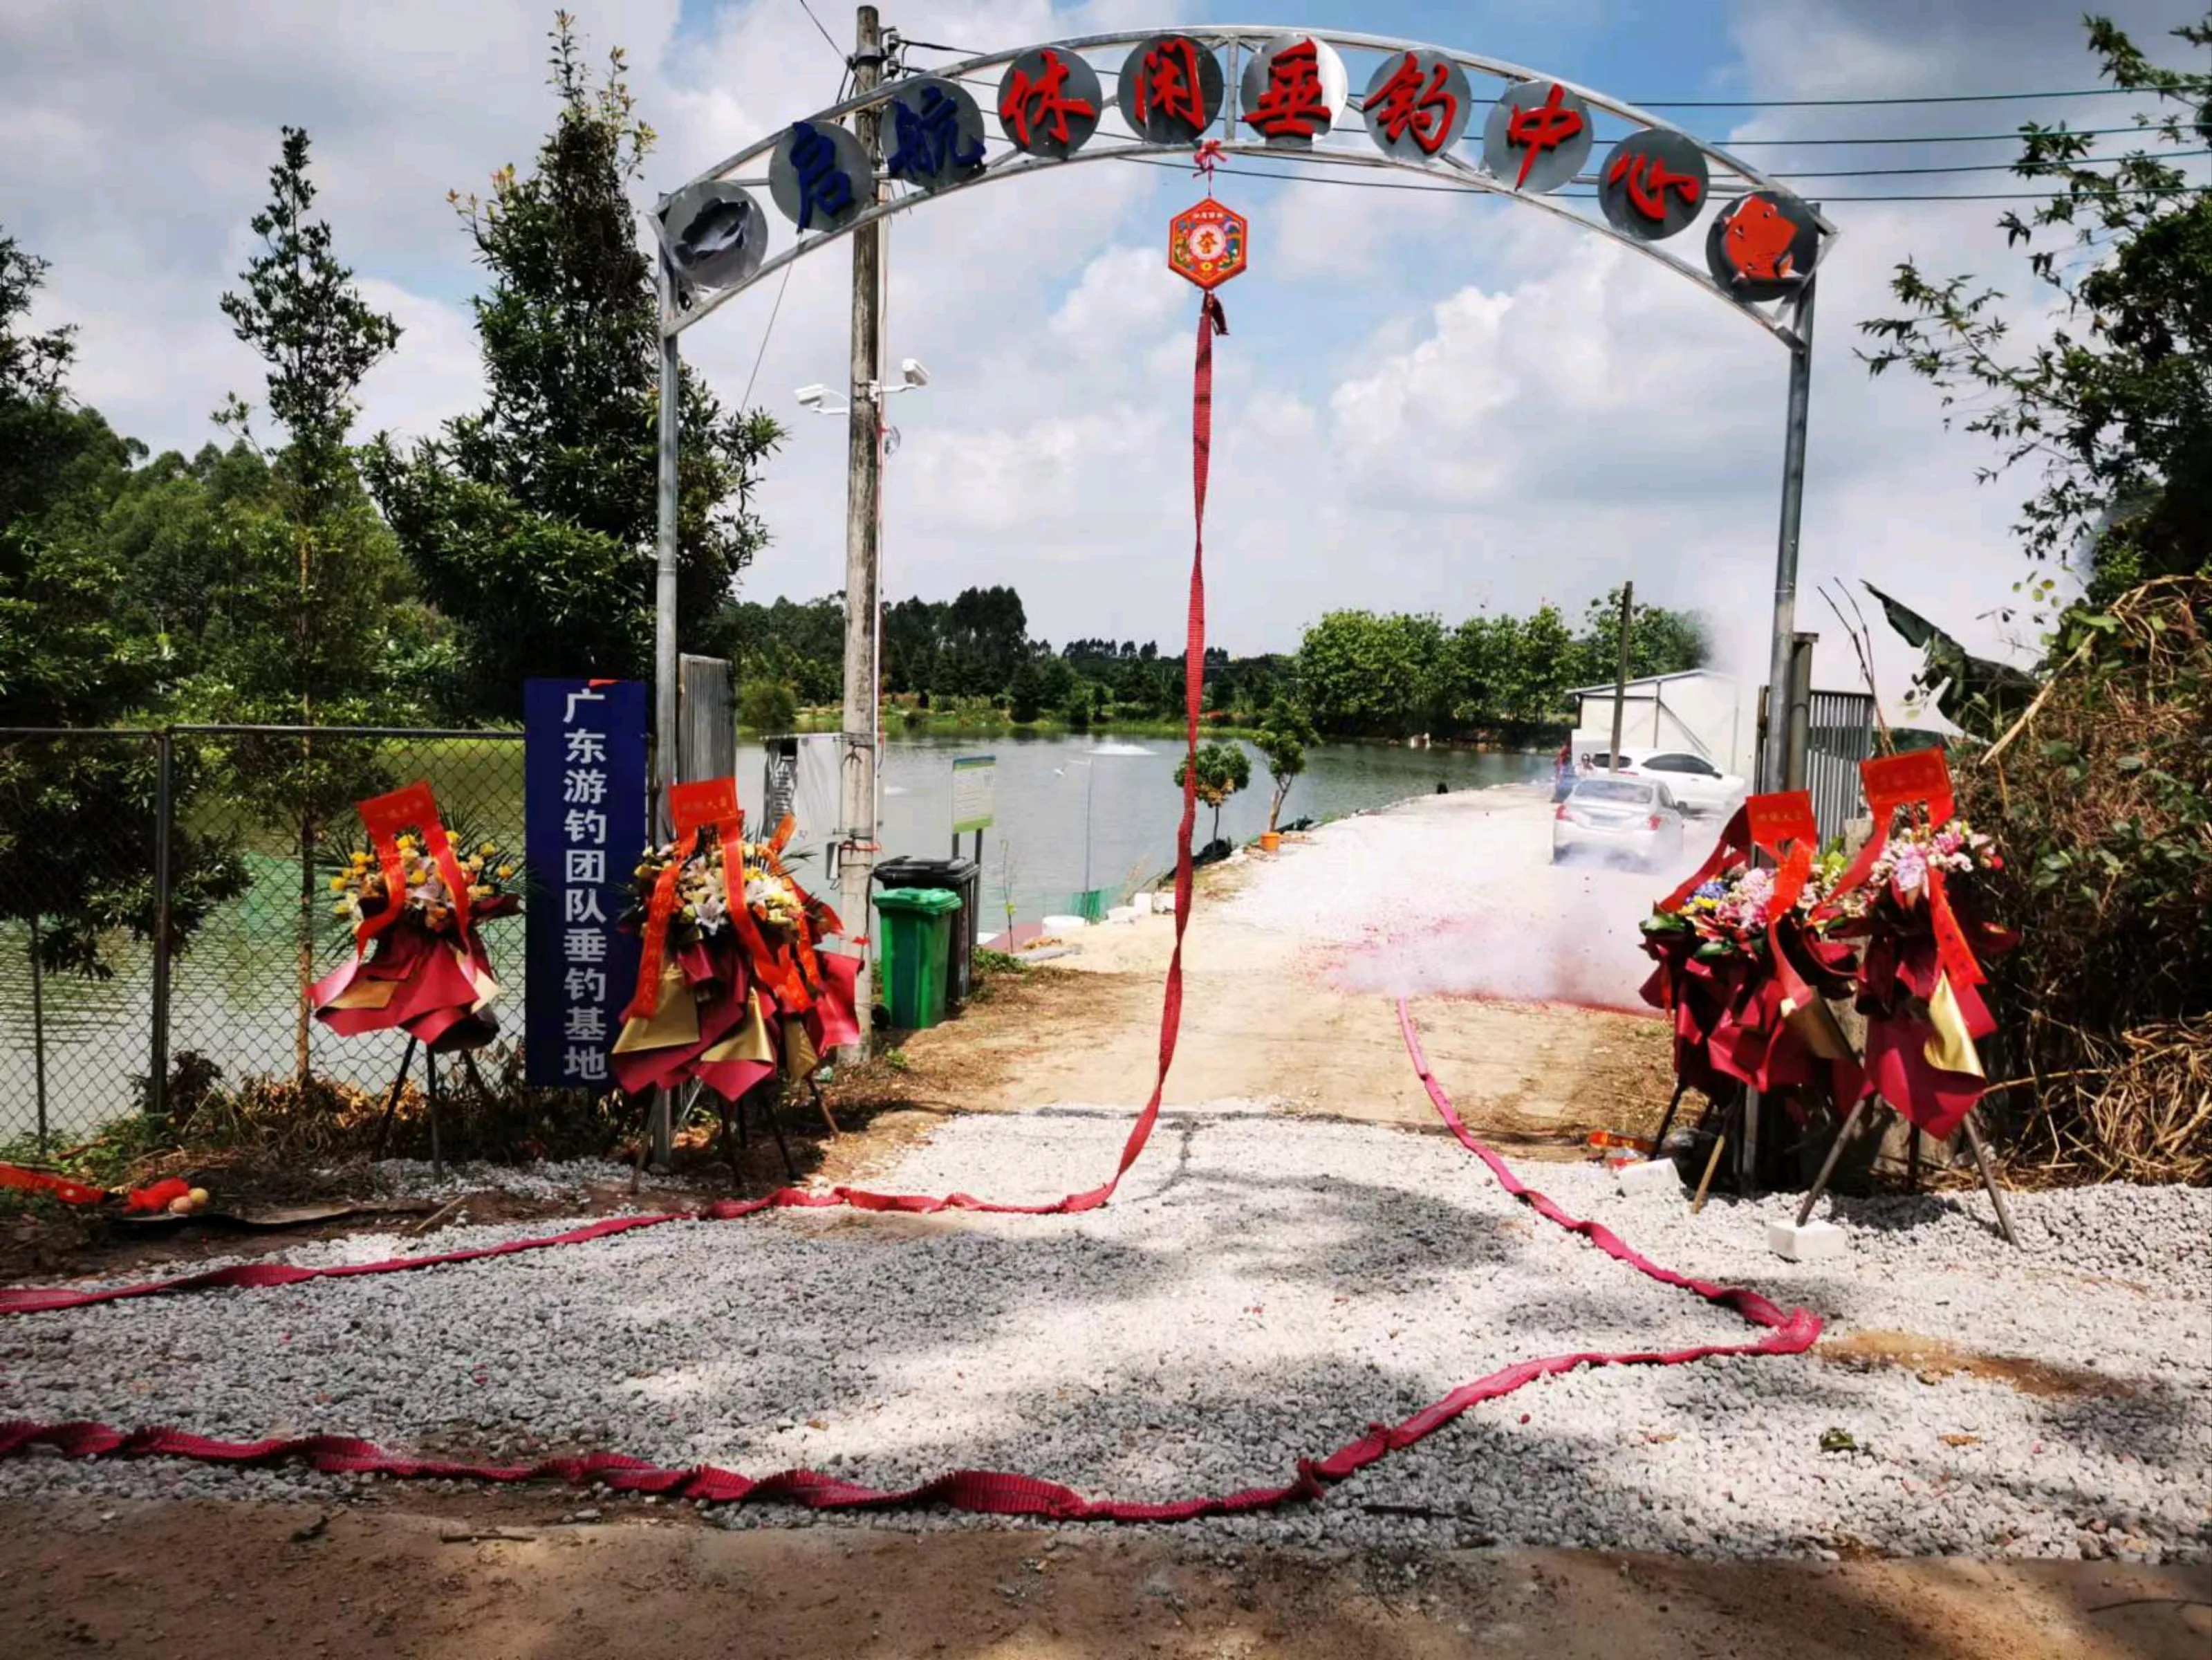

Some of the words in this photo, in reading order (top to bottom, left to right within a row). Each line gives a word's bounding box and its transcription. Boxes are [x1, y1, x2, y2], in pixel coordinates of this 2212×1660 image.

[788, 37, 1700, 232] 启航休闲垂钓中心
[562, 688, 608, 1080] 广东游钓团队垂钓基地
